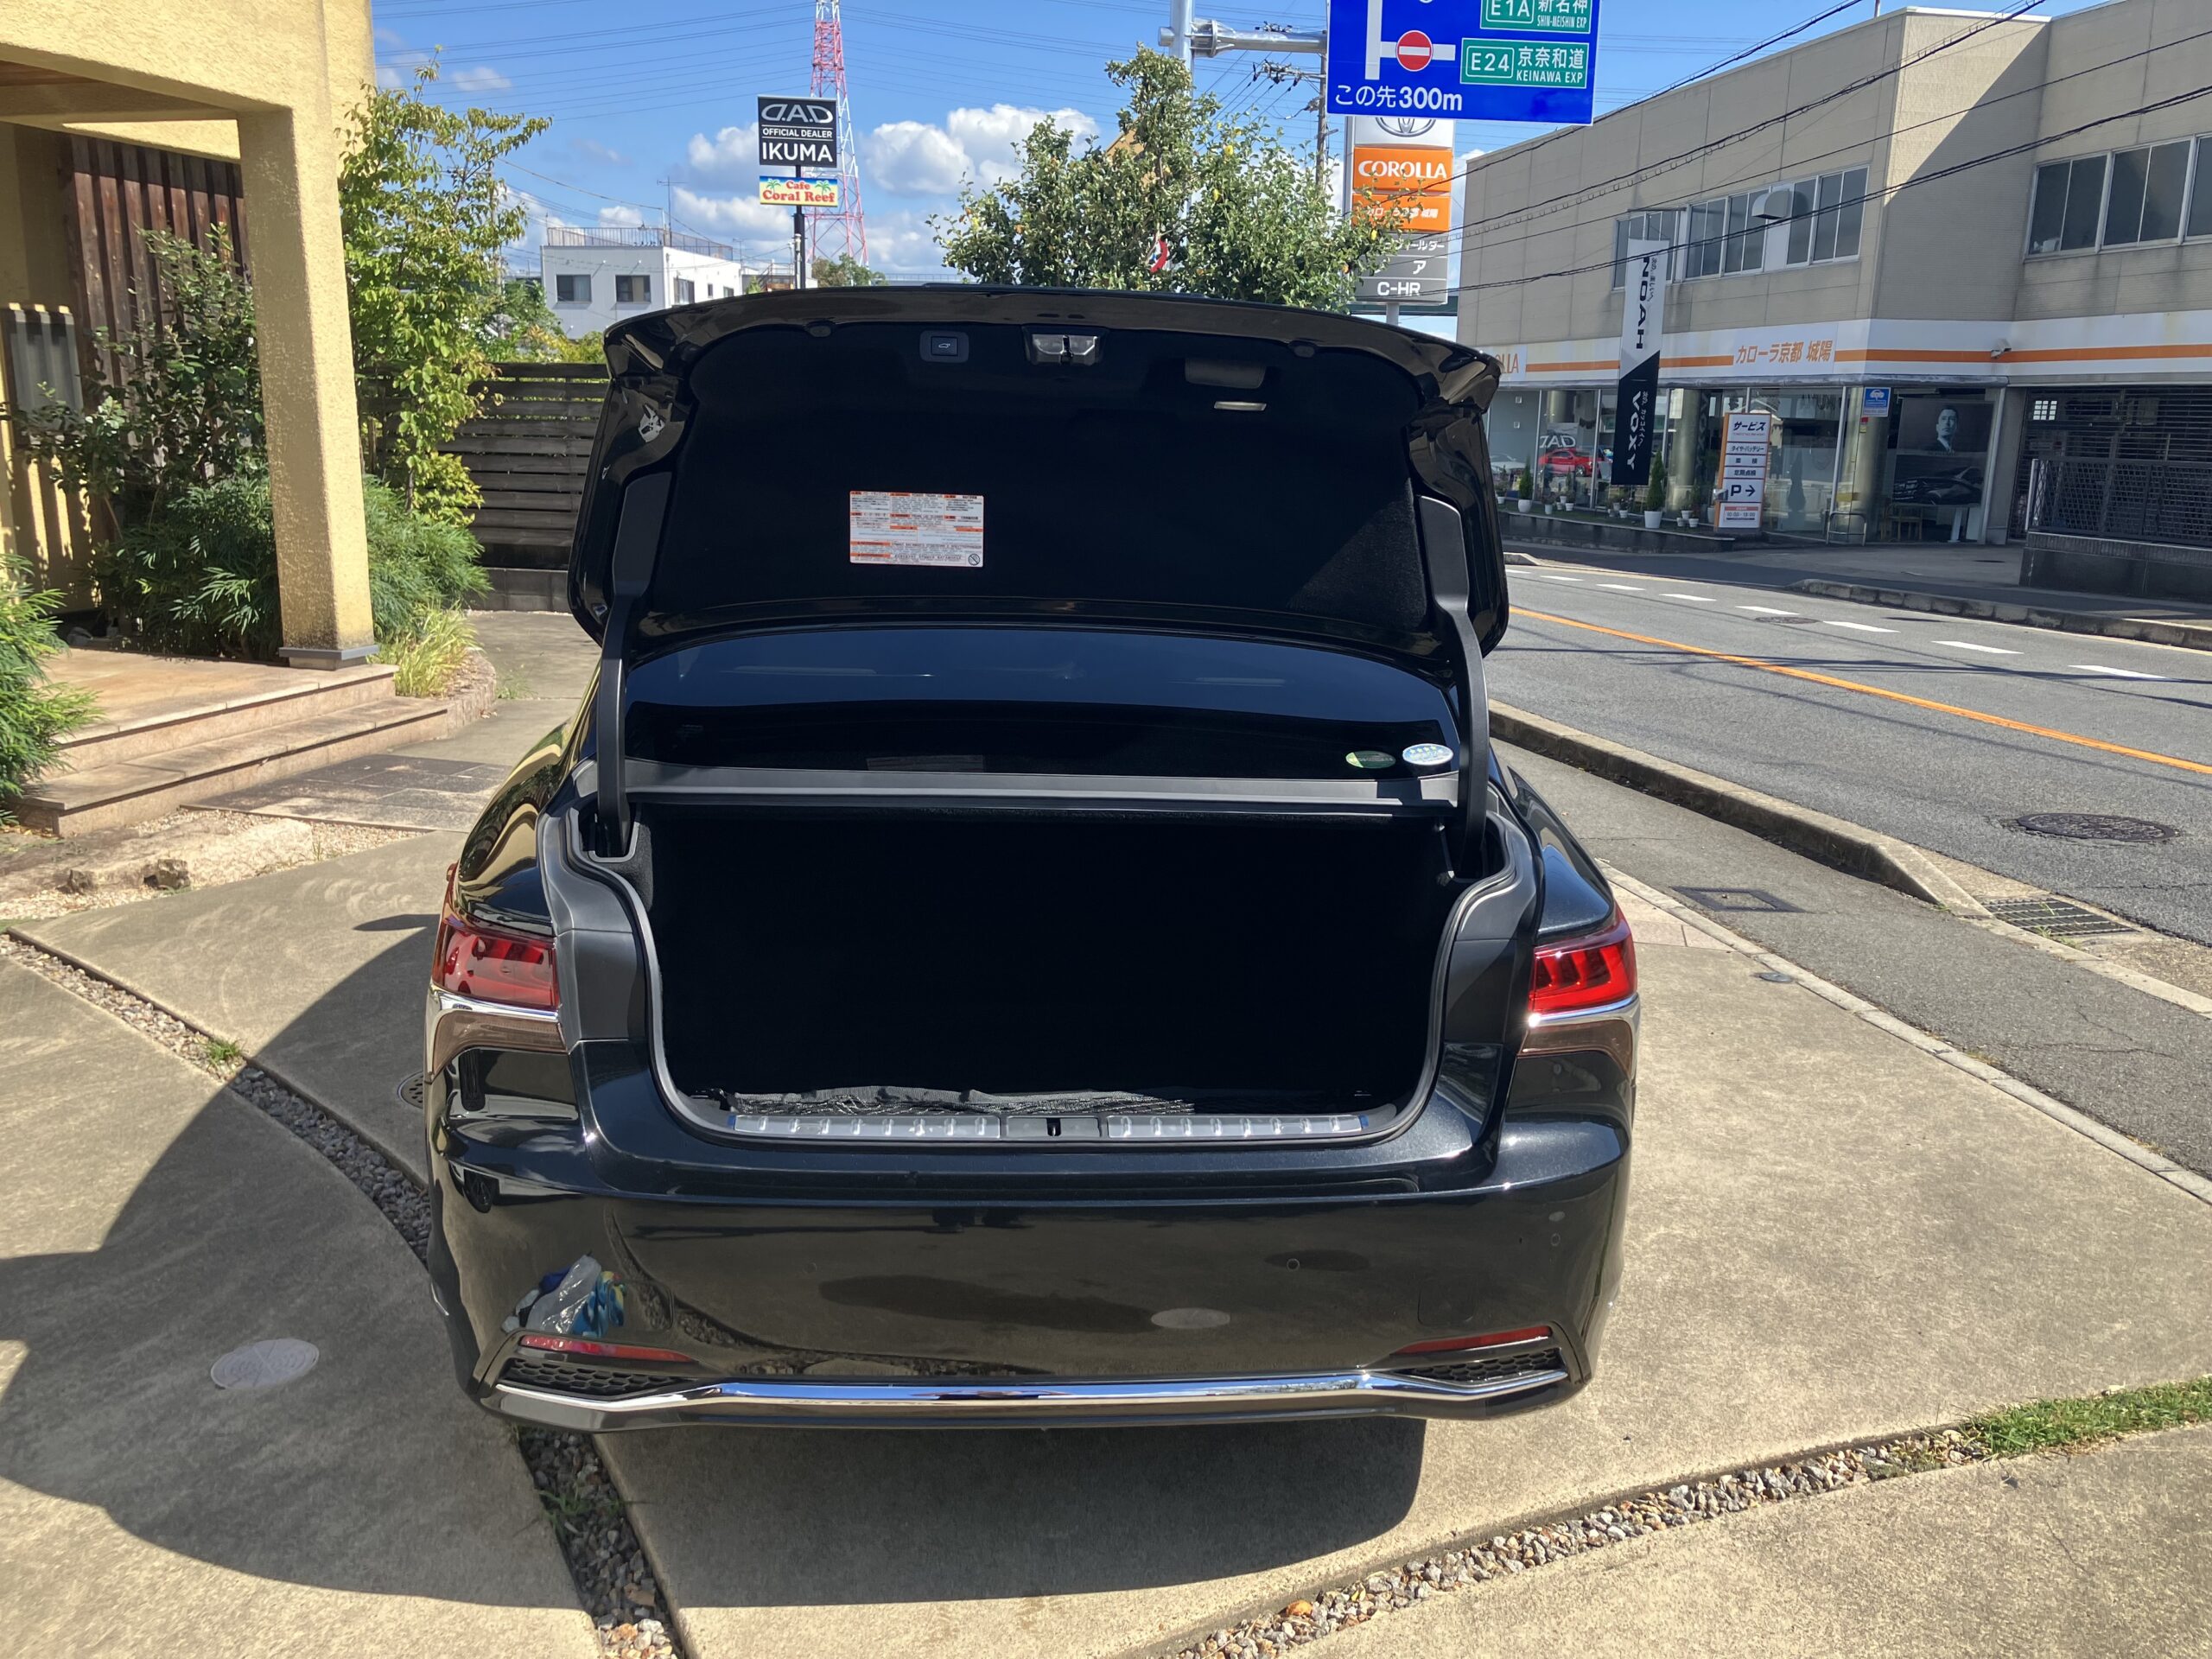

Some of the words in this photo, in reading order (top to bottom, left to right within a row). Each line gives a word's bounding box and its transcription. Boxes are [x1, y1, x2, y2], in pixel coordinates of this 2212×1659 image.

[1491, 0, 1530, 17] E1A
[1537, 0, 1588, 14] 新名神
[1536, 15, 1575, 28] SHIN-MEISHIN
[1576, 17, 1587, 28] EXP
[1471, 53, 1510, 73] E24
[1516, 46, 1585, 70] 京奈和道
[1516, 69, 1561, 83] KEINAWA
[1564, 71, 1583, 84] EXP
[1335, 85, 1462, 111] この先300m
[762, 127, 799, 137] OFFICIAL
[800, 129, 833, 138] DEALER
[762, 142, 834, 162] IKUMA
[1357, 160, 1447, 179] COROLLA
[785, 181, 810, 190] Cafe
[762, 190, 801, 201] Coral
[804, 191, 836, 203] Reef
[1377, 282, 1421, 296] C-HR
[1636, 257, 1650, 349] NOAH
[1736, 341, 1804, 364] カローラ京都
[1806, 340, 1833, 362] 城陽
[1626, 391, 1642, 471] VOXY
[1733, 421, 1767, 431] サービス
[1730, 484, 1742, 496] P
